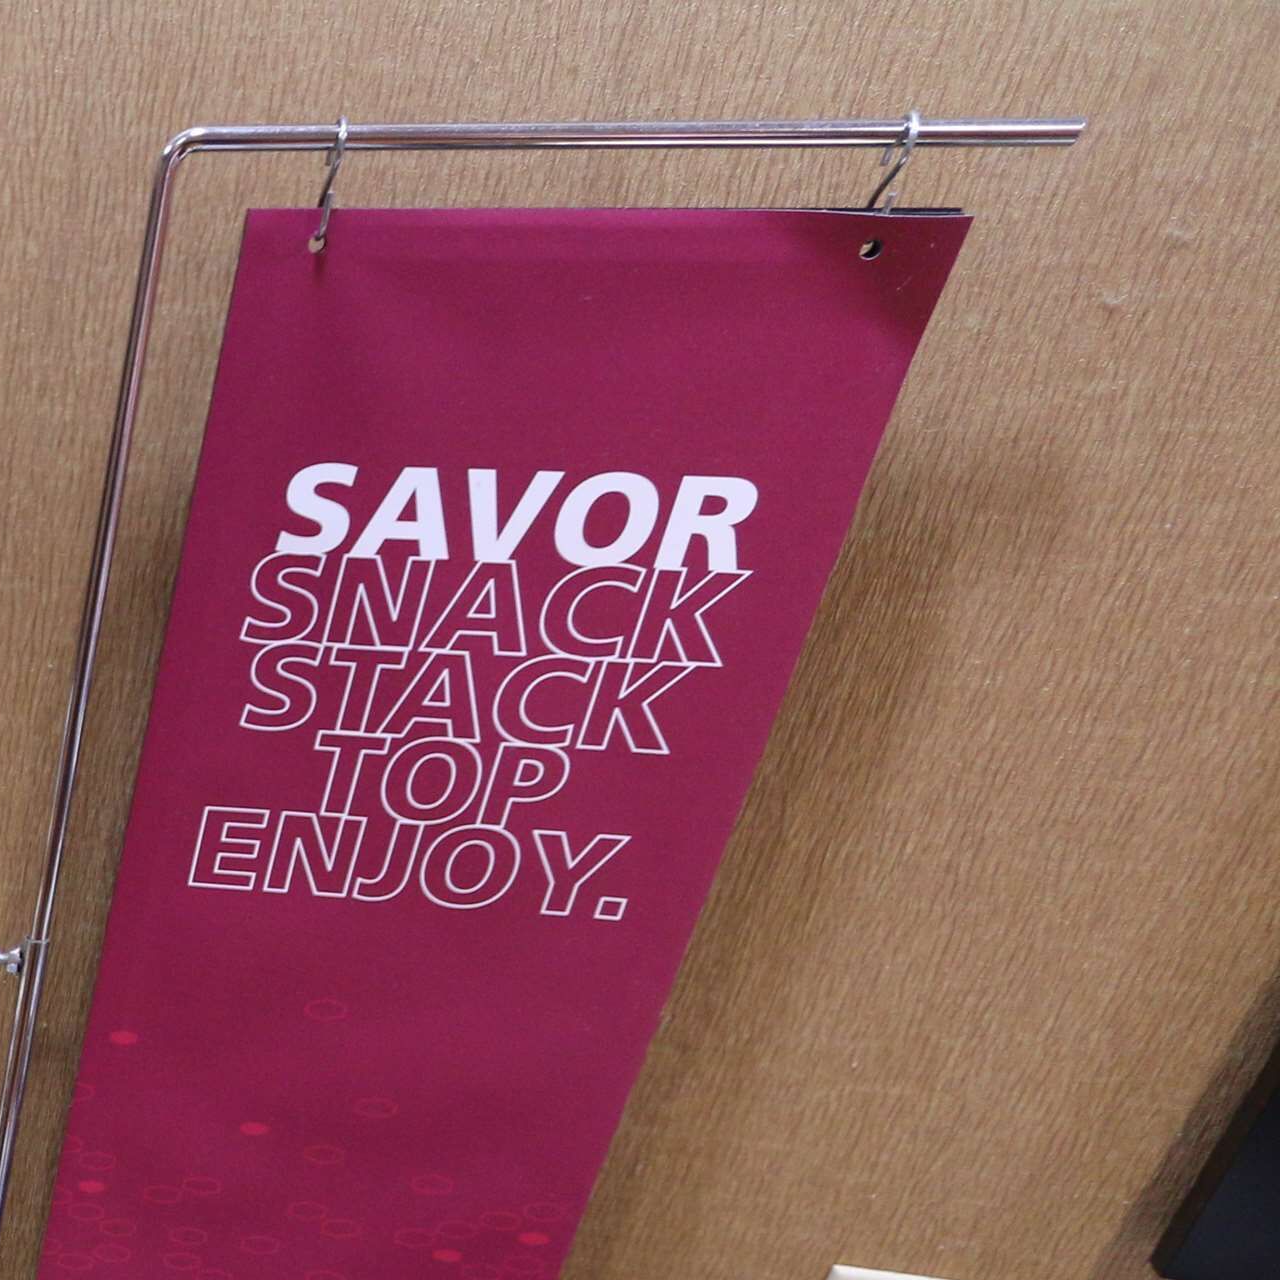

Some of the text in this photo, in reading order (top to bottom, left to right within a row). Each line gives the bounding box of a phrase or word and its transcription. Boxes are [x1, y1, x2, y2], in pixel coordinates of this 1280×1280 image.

[275, 462, 759, 571] SAVOR
[239, 550, 753, 668] SNACK
[239, 640, 699, 755] STACK
[313, 730, 571, 829] TOP
[187, 806, 632, 921] ENJOY.
